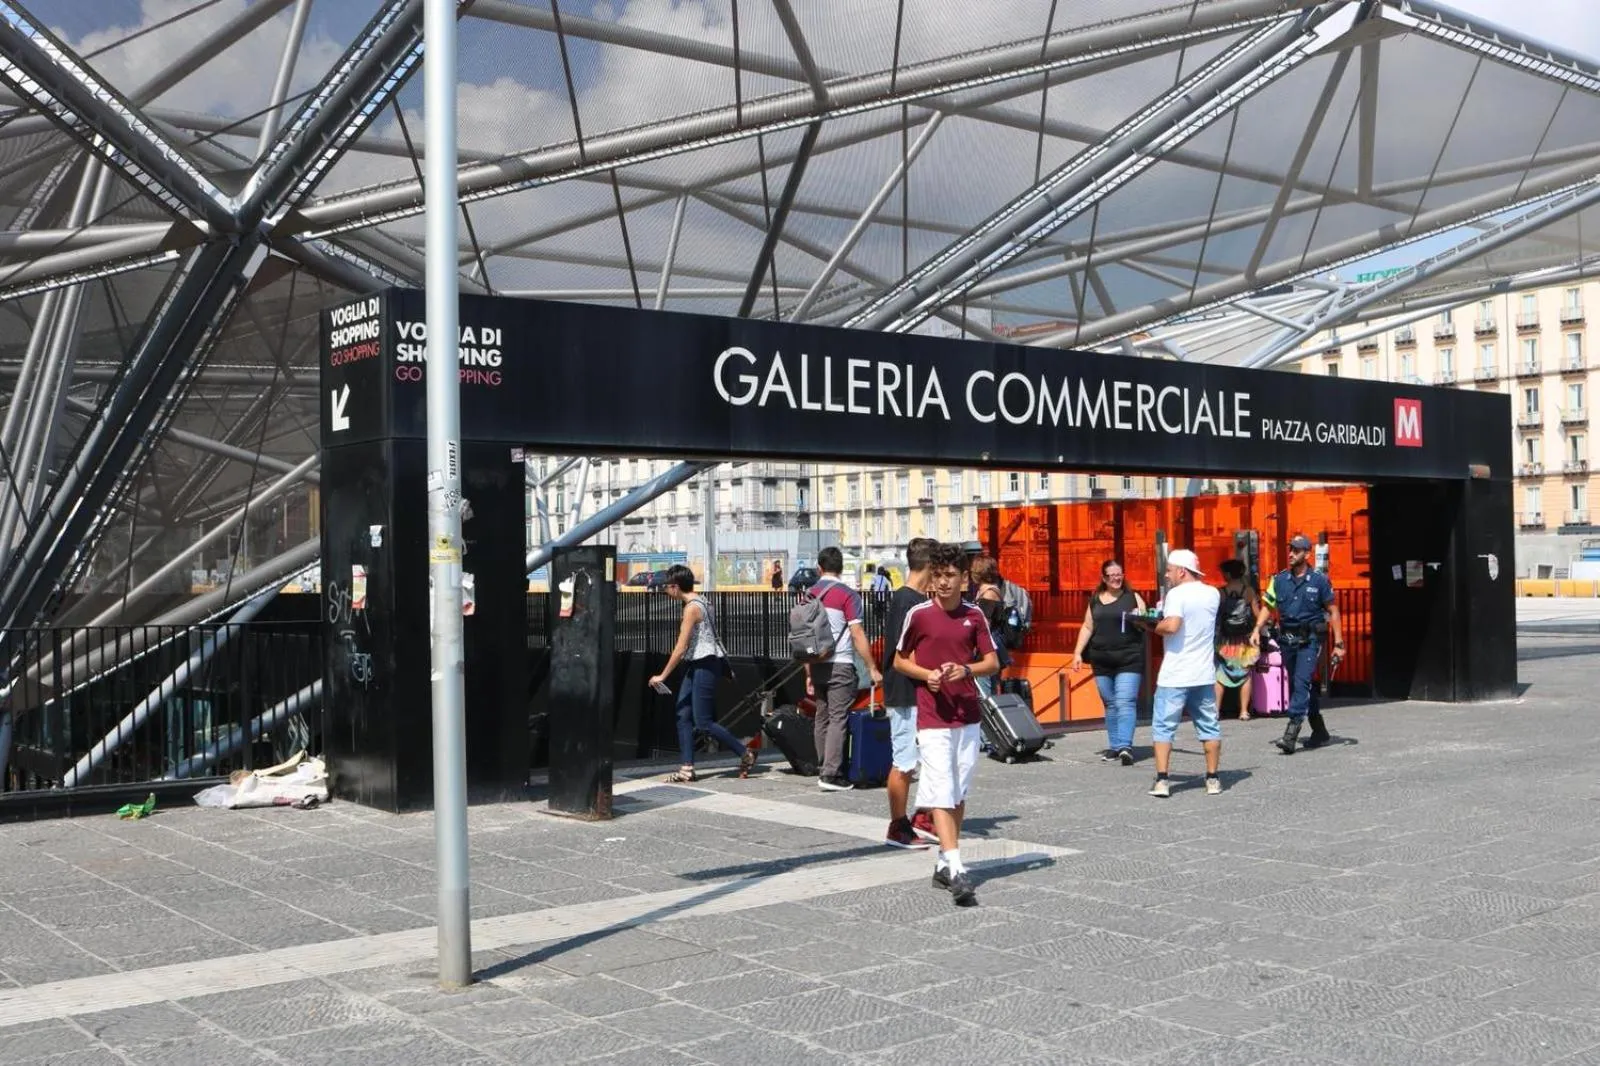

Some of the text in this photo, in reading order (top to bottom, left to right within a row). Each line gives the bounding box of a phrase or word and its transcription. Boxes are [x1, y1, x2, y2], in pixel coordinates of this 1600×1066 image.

[331, 296, 380, 327] VOGLIA DI
[331, 319, 380, 349] SHOPPING
[481, 327, 502, 346] DI
[331, 341, 380, 366] GO SHOPPING
[395, 365, 422, 382] GO
[713, 346, 1420, 446] GALLERIA COMMERCIALE PIAZZA GARIBALDI M
